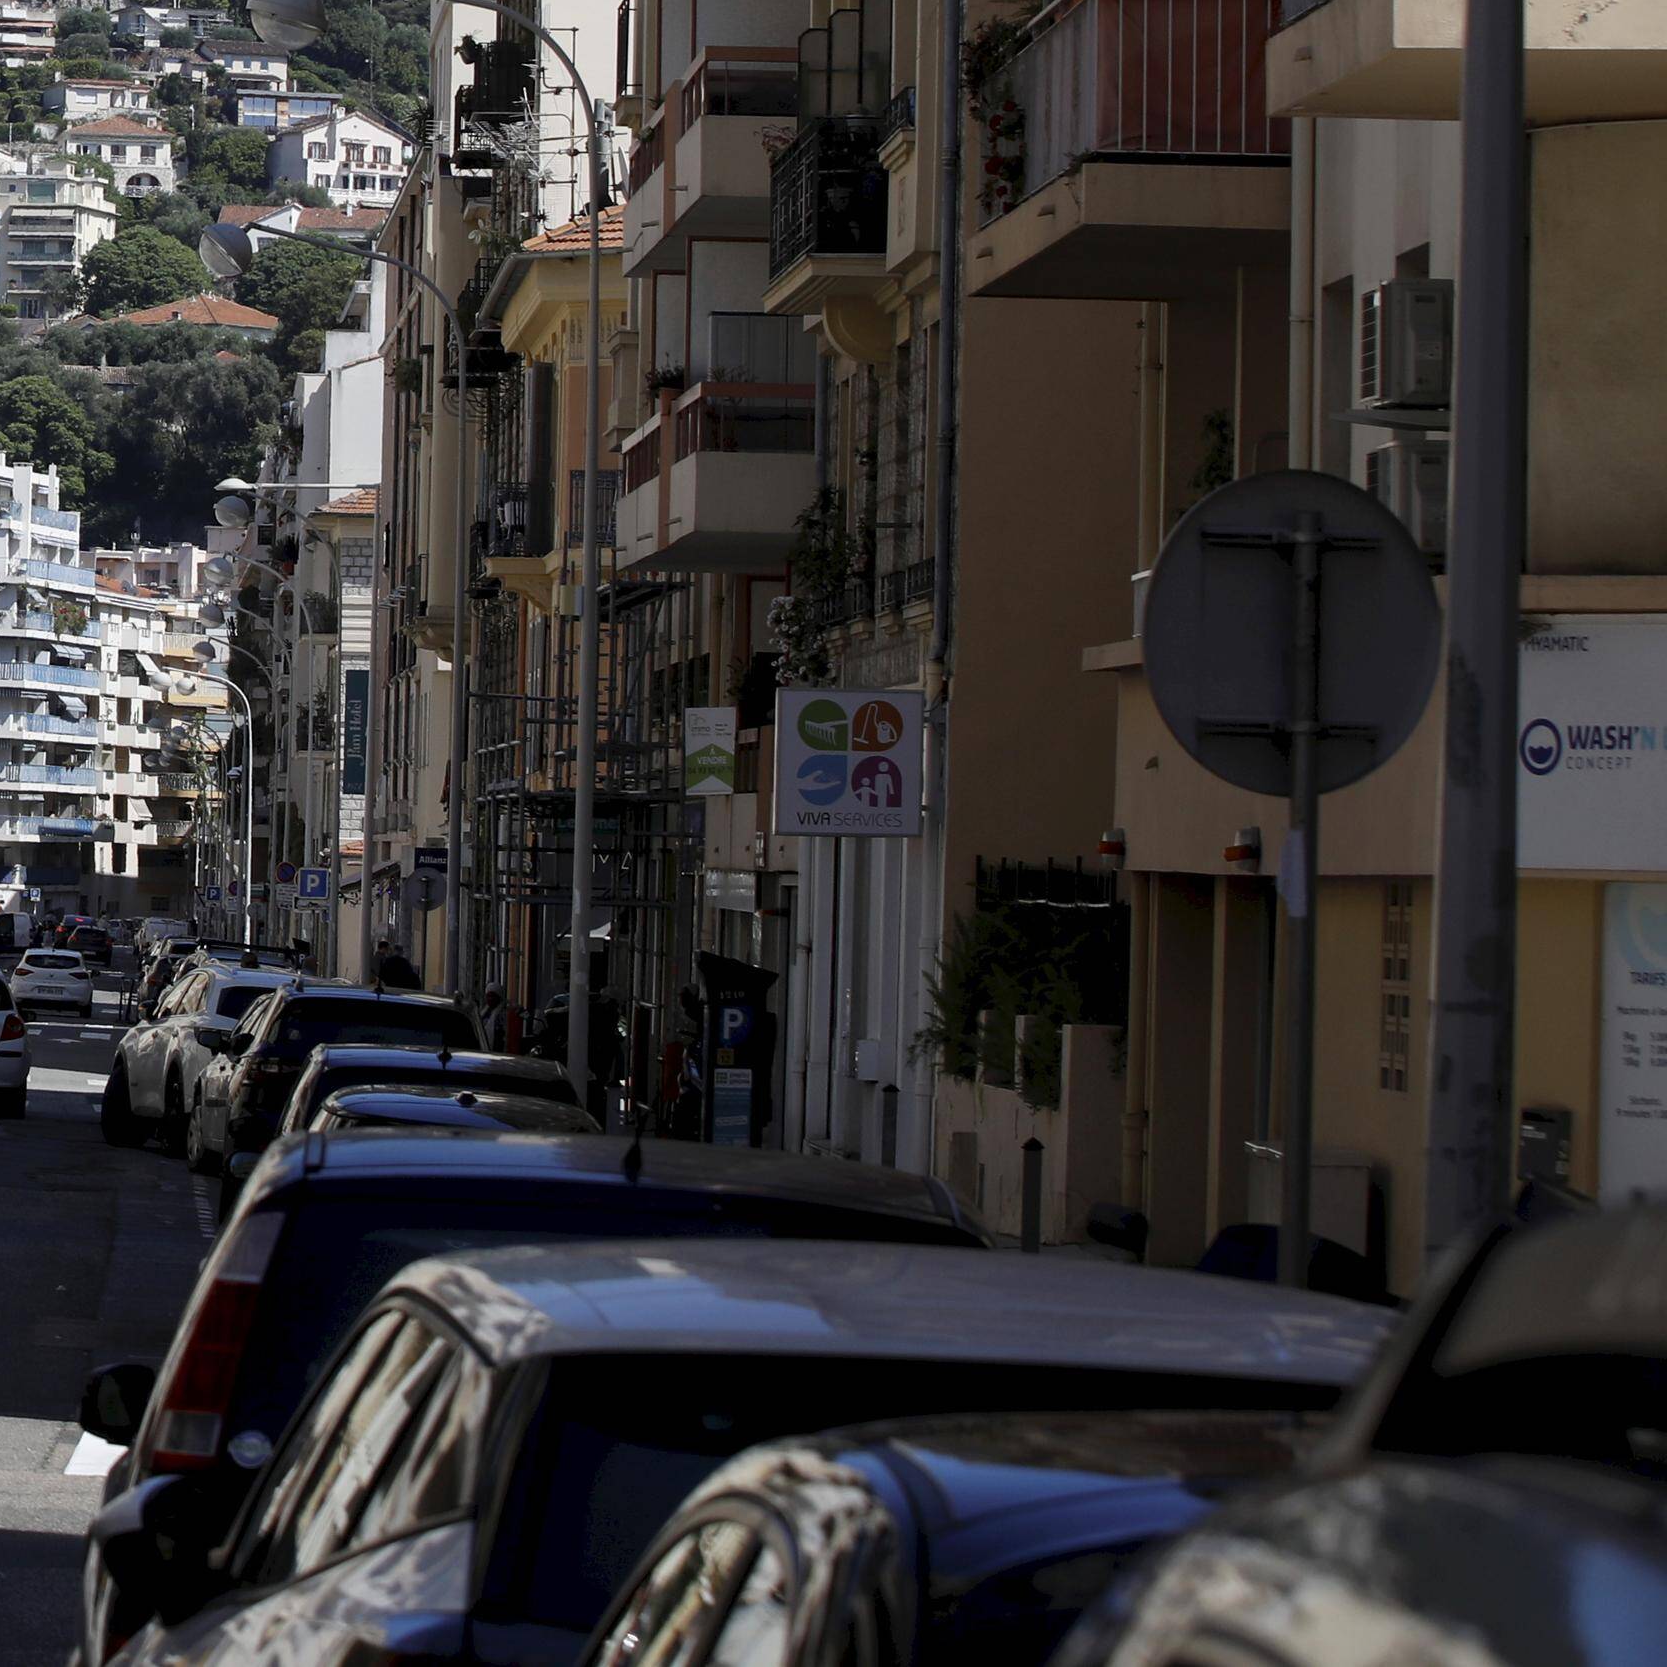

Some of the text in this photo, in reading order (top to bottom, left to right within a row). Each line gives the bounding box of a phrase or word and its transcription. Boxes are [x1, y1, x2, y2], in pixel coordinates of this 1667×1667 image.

[697, 756, 728, 765] VENDRE
[1566, 757, 1632, 770] CONCEPT
[796, 812, 904, 828] VIVA SERVICES
[419, 853, 447, 864] Allianz
[306, 874, 320, 893] P
[723, 1007, 744, 1040] P
